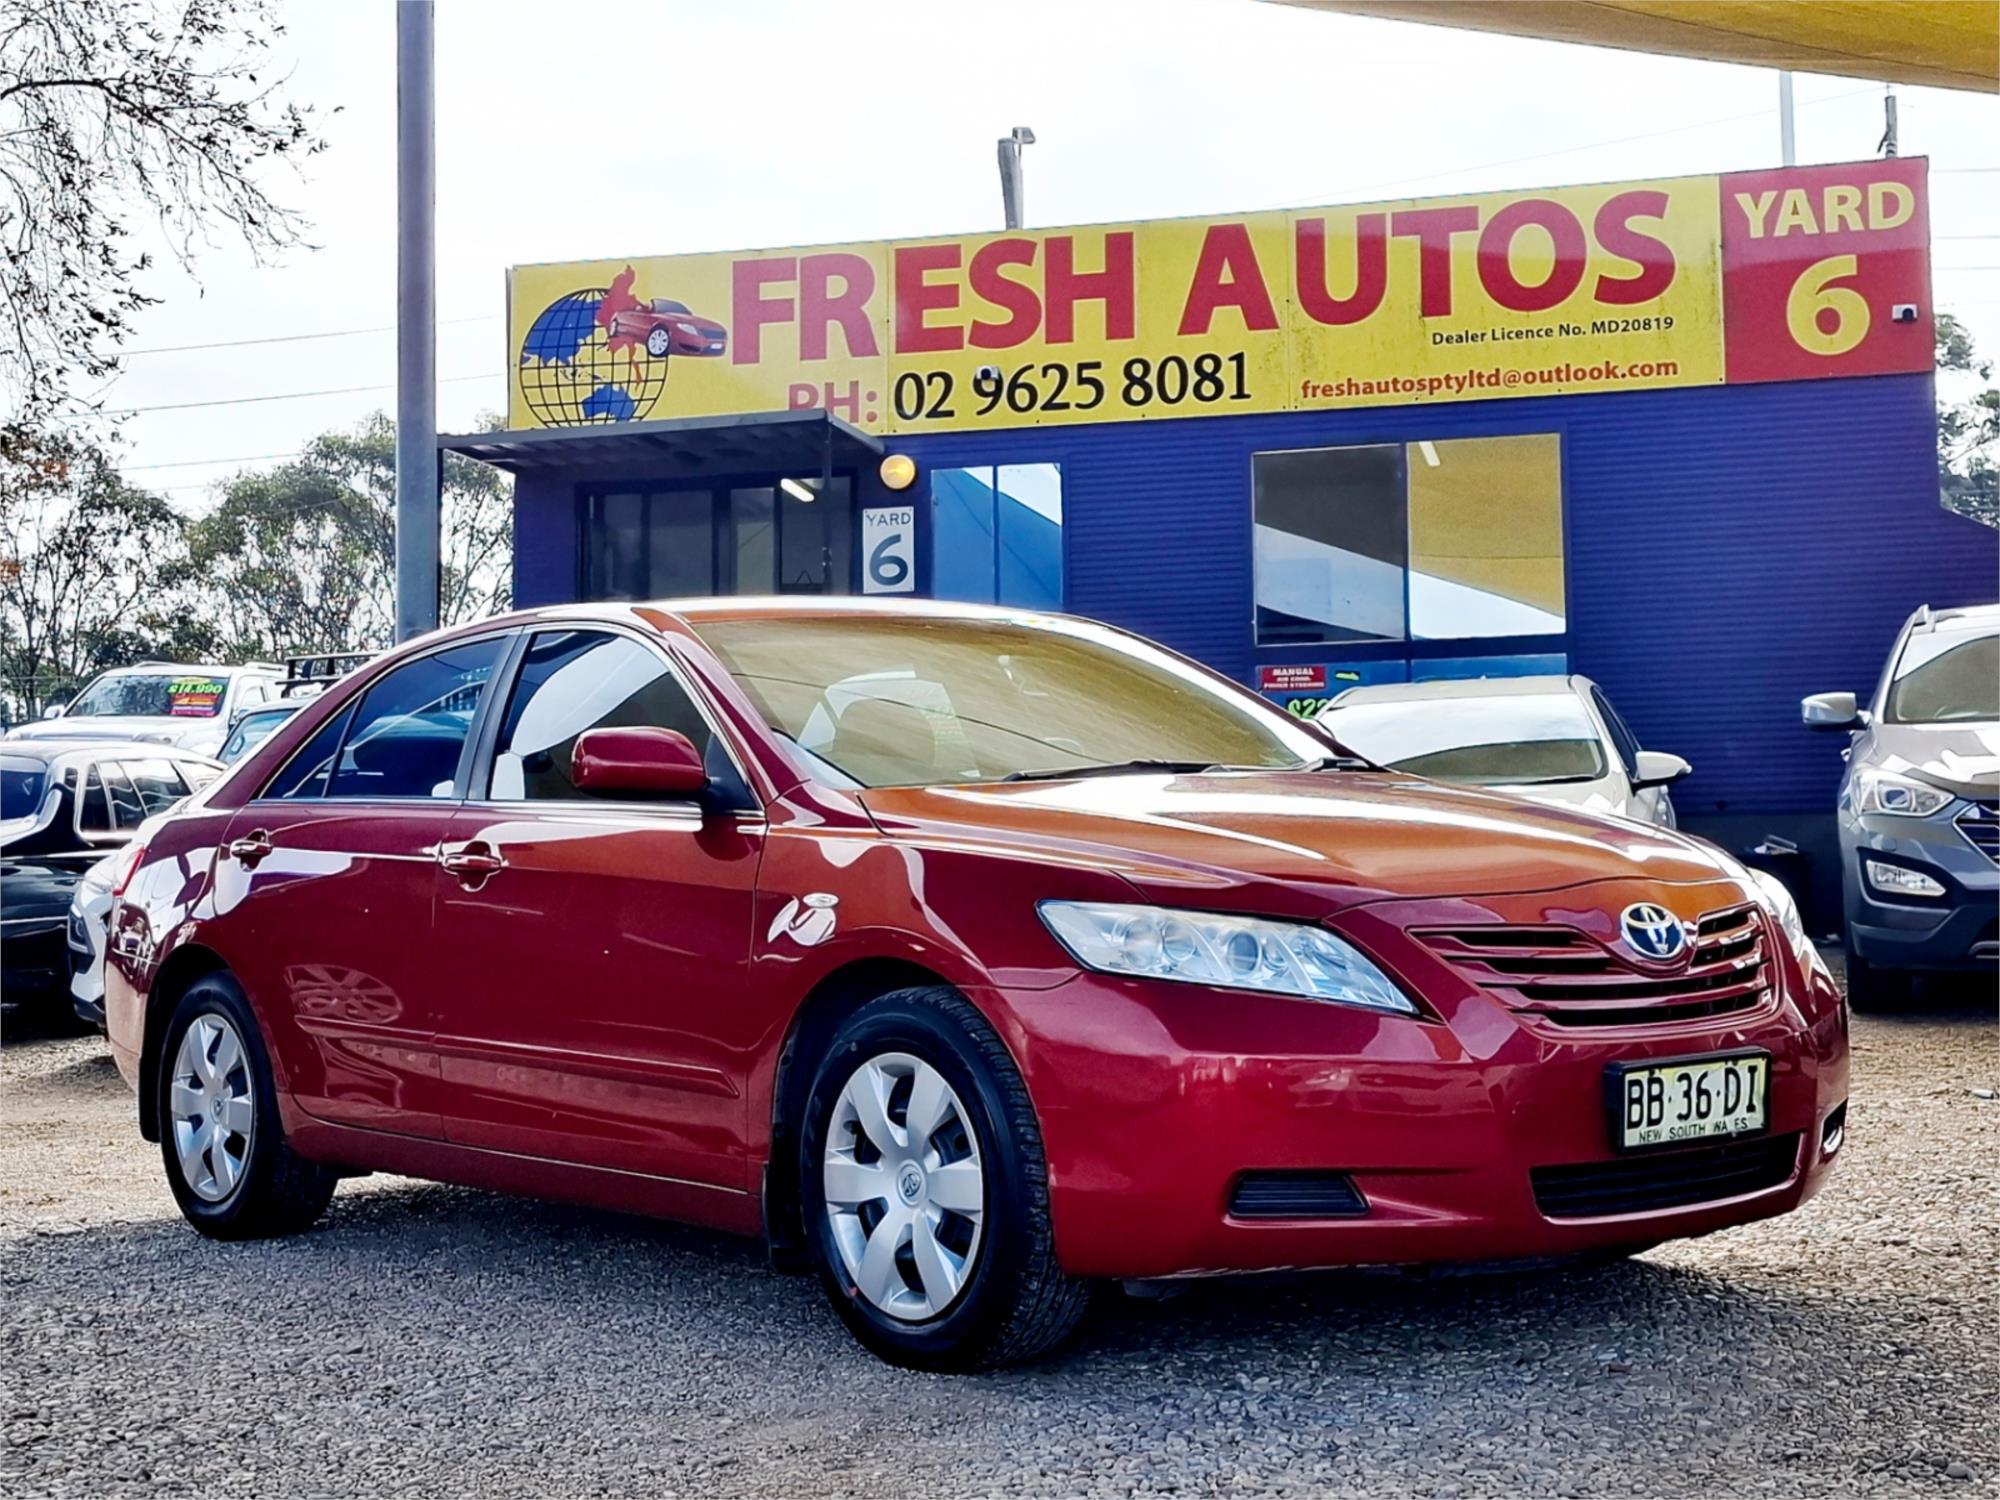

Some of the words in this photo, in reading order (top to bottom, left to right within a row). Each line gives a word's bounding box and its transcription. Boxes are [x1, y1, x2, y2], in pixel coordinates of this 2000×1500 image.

[1735, 182, 1915, 239] YARD
[732, 231, 1136, 365] FRESH
[1178, 190, 1676, 336] AUTOS
[1786, 255, 1870, 356] 6
[1432, 328, 1487, 345] Dealer
[1491, 325, 1553, 341] Licence
[1558, 323, 1586, 337] No.
[1591, 316, 1674, 335] MD20819
[789, 380, 877, 423] PH:
[894, 371, 955, 420] 02
[973, 362, 1104, 416] 9625
[1122, 352, 1251, 406] 8081
[1301, 361, 1678, 399] freshautosptyltd@outlook.com
[866, 513, 911, 526] YARD
[869, 534, 908, 585] 6
[1273, 668, 1314, 676] MANUAL
[1639, 1130, 1661, 1143] NEW
[1669, 1124, 1706, 1140] SOUTH
[1713, 1117, 1748, 1132] WAES
